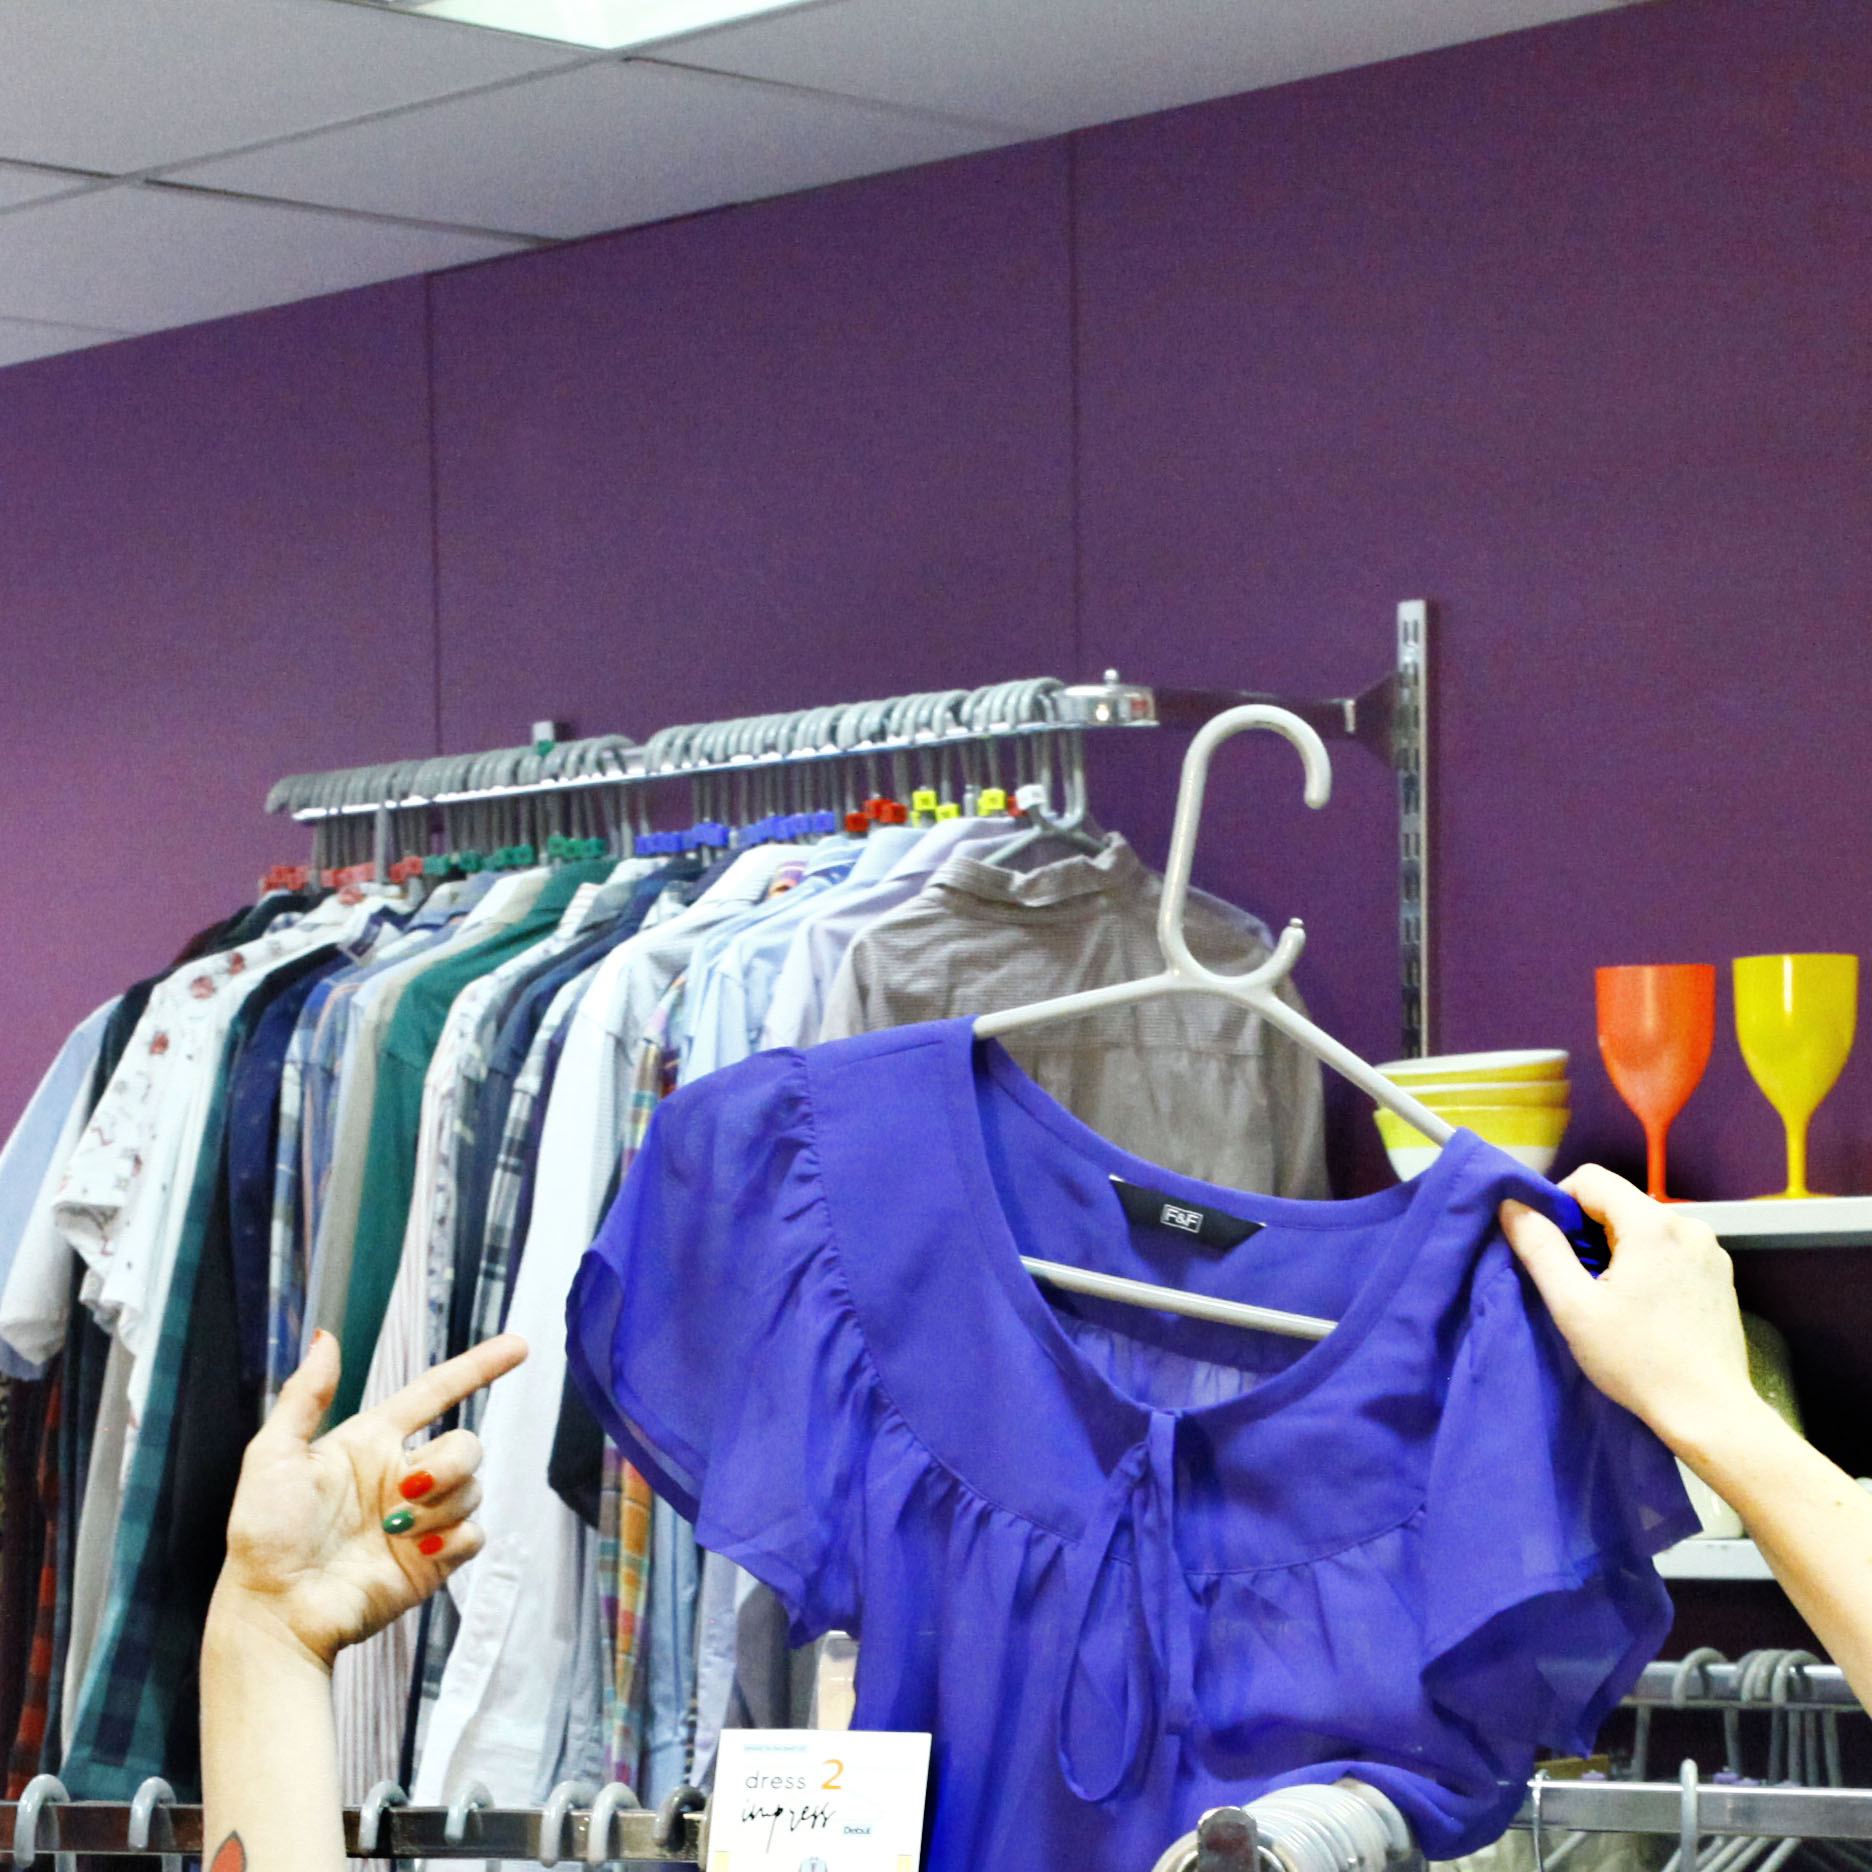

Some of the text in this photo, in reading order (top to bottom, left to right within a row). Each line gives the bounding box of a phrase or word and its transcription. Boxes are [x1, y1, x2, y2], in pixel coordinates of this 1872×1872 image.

[1166, 1208, 1199, 1228] F&F
[745, 1759, 845, 1790] dress 2
[741, 1799, 835, 1854] impress
